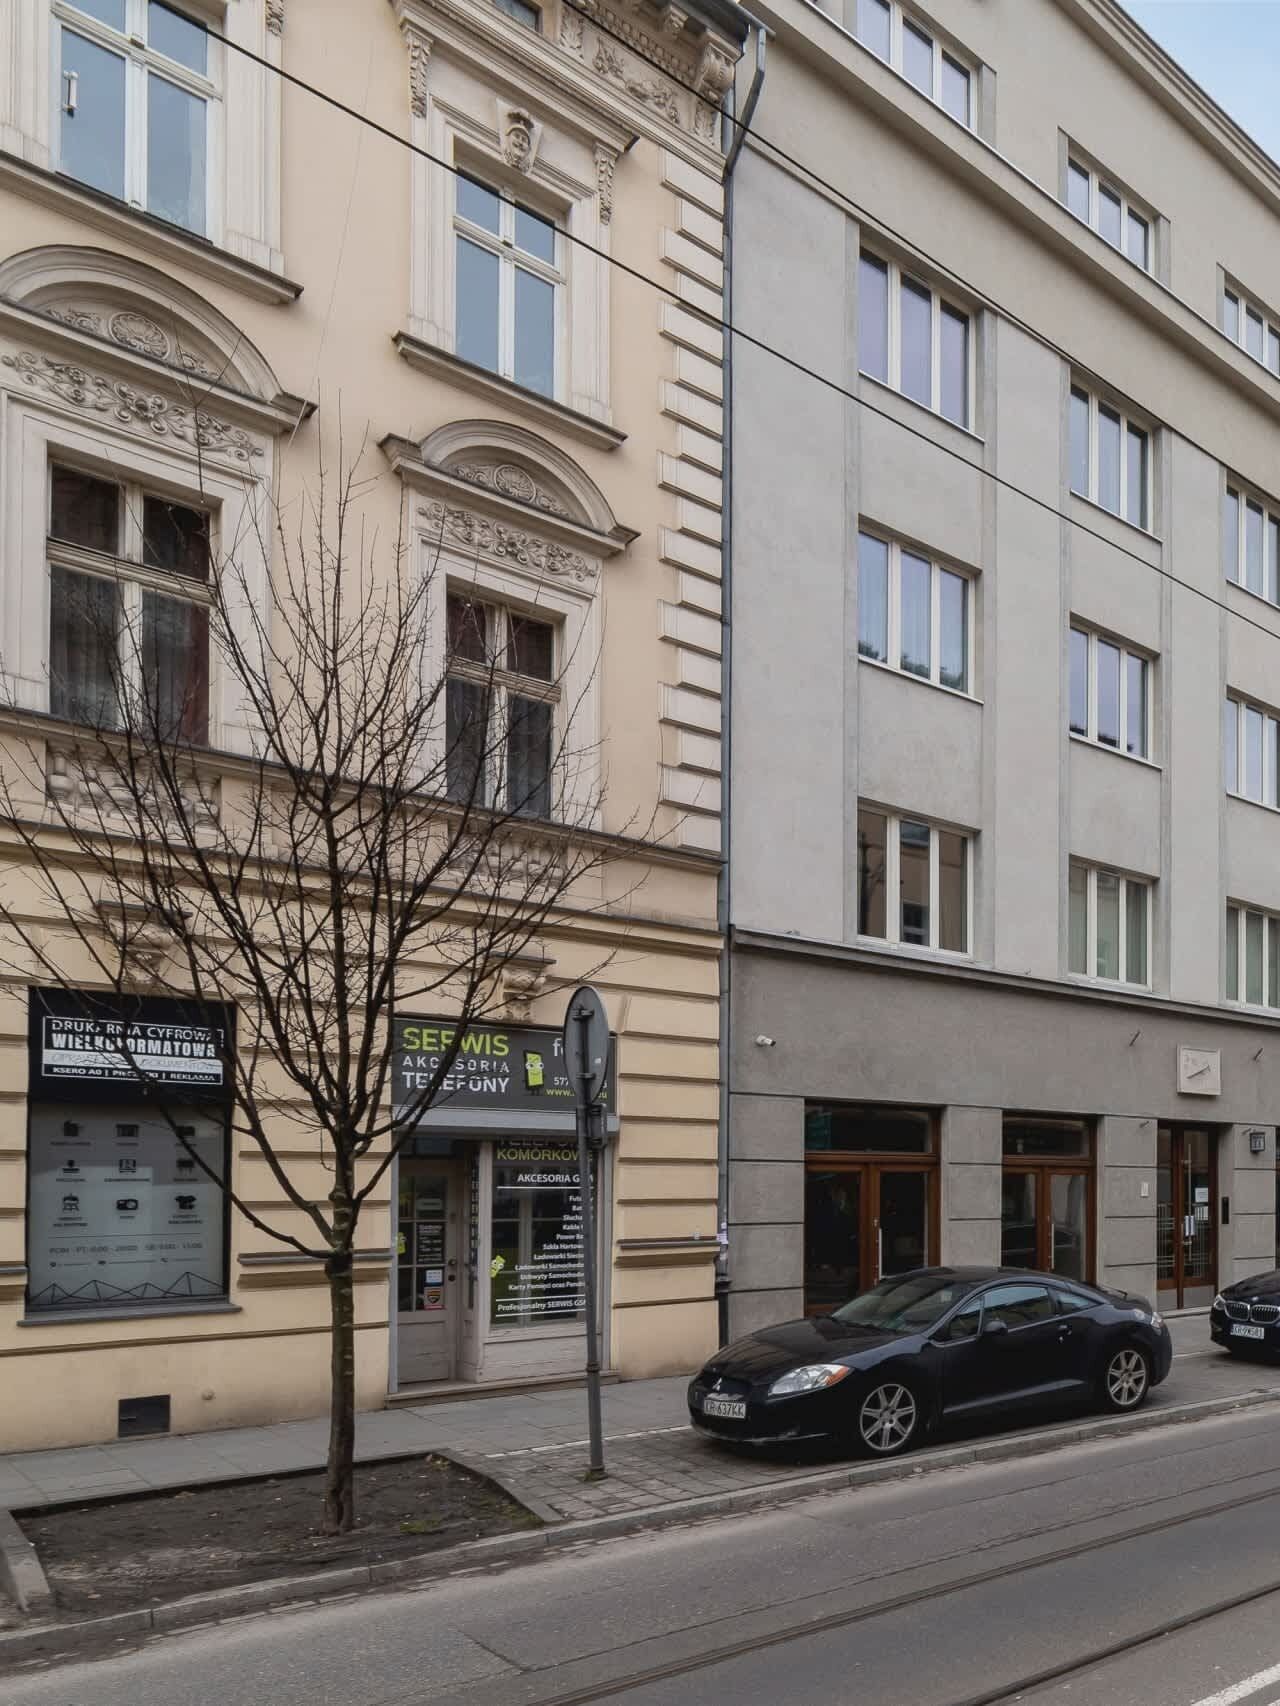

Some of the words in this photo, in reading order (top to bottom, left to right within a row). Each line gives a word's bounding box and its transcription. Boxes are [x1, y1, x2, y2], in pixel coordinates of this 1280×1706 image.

[402, 1056, 510, 1073] AKCSORIA
[53, 1067, 86, 1075] KSERO
[170, 1073, 215, 1081] REKLAMA
[517, 1174, 571, 1183] AKCESORIA
[547, 1300, 573, 1308] SERWIS
